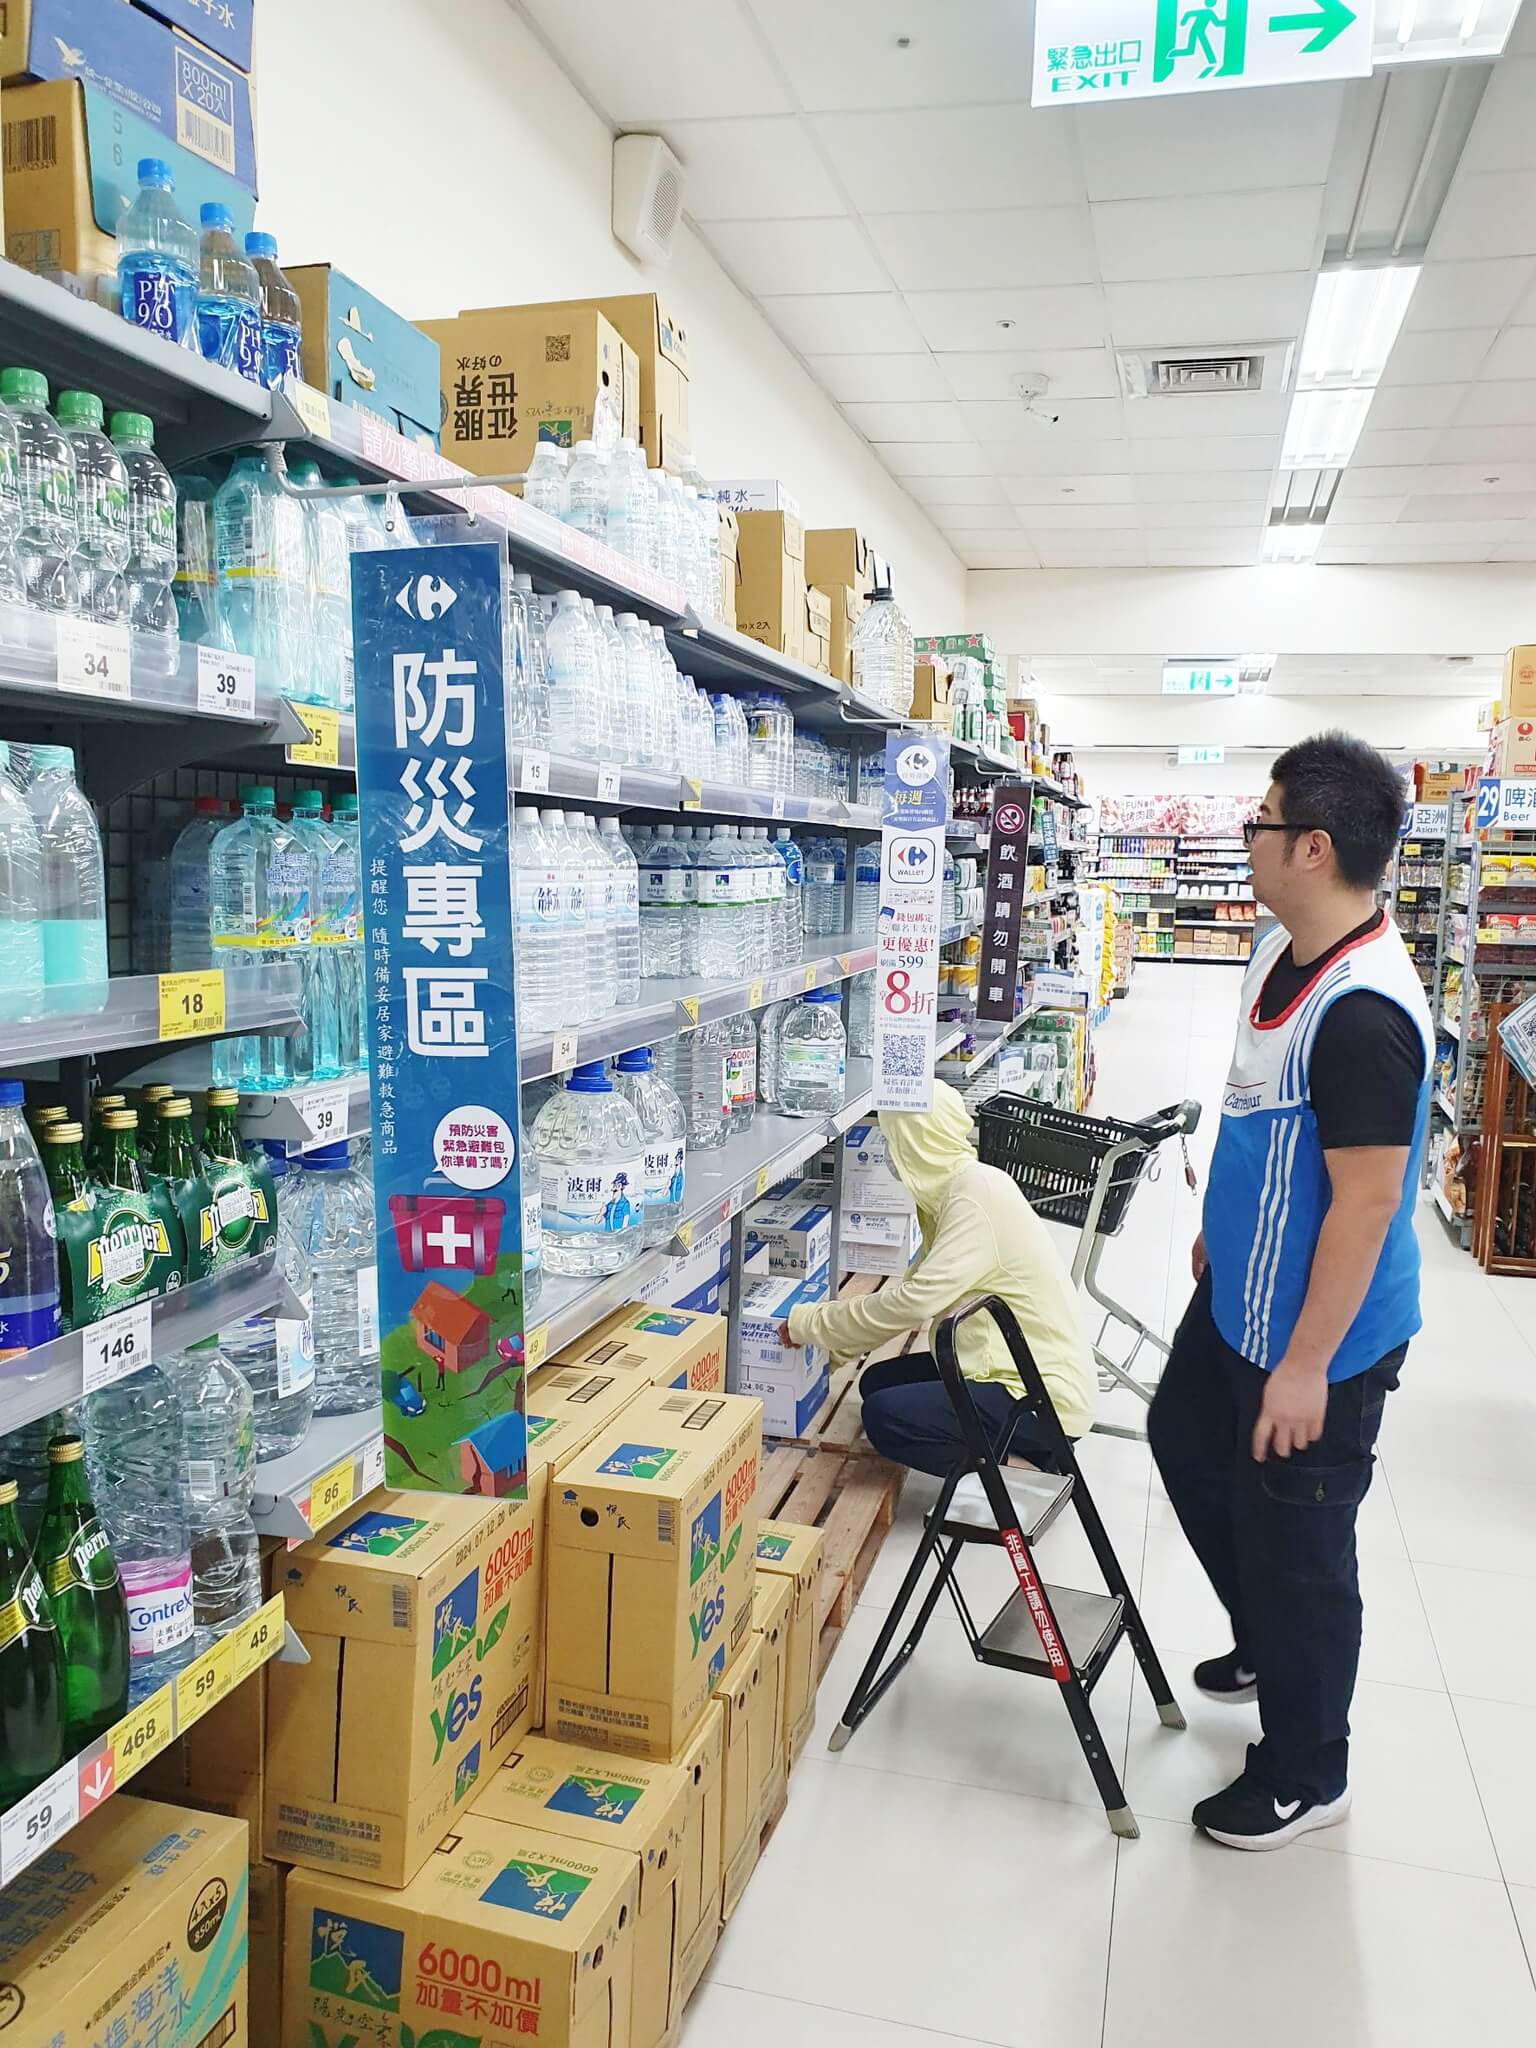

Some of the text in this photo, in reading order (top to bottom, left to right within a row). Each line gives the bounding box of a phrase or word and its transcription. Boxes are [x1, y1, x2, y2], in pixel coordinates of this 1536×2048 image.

[1047, 39, 1142, 71] 緊急出口
[182, 60, 226, 102] 800ml
[1051, 70, 1138, 93] EXIT
[138, 302, 173, 329] 9.0
[456, 354, 502, 371] の好水
[453, 371, 519, 407] 世界
[453, 408, 519, 442] 征服
[84, 652, 110, 678] 34
[216, 673, 237, 695] 39
[309, 728, 323, 747] 5
[531, 765, 541, 779] 15
[893, 789, 937, 806] 每週三
[1479, 786, 1499, 817] 29
[1415, 825, 1438, 833] Asian
[1416, 808, 1447, 825] 亞洲
[1503, 812, 1530, 821] Beer
[391, 647, 490, 1058] 防災專區
[897, 868, 925, 876] WALLET
[369, 858, 390, 916] 提醒您
[988, 843, 1018, 1003] 飲酒請勿開車
[881, 936, 935, 953] 更優惠!
[181, 993, 204, 1015] 18
[371, 927, 398, 1155] 隨時備妥居家避難救急商品
[560, 1042, 571, 1056] 54
[316, 1110, 333, 1130] 39
[447, 1123, 499, 1138] 預防災害
[442, 1139, 506, 1154] 緊急避難包
[440, 1154, 509, 1169] 你準備了嗎?
[567, 1176, 602, 1193] 波爾
[100, 1333, 135, 1364] 146
[689, 1346, 721, 1388] 6000ml
[724, 1449, 758, 1506] 6000ml
[323, 1482, 340, 1505] 86
[484, 1519, 535, 1585] 6000ml
[482, 1549, 534, 1614] 加量不加價
[128, 1590, 193, 1633] Contrex
[249, 1624, 269, 1650] 48
[194, 1668, 216, 1699] 59
[121, 1717, 157, 1758] 468
[25, 1804, 53, 1841] 59
[418, 1941, 541, 2006] 6000ml
[415, 1980, 540, 2037] 加量不加價
